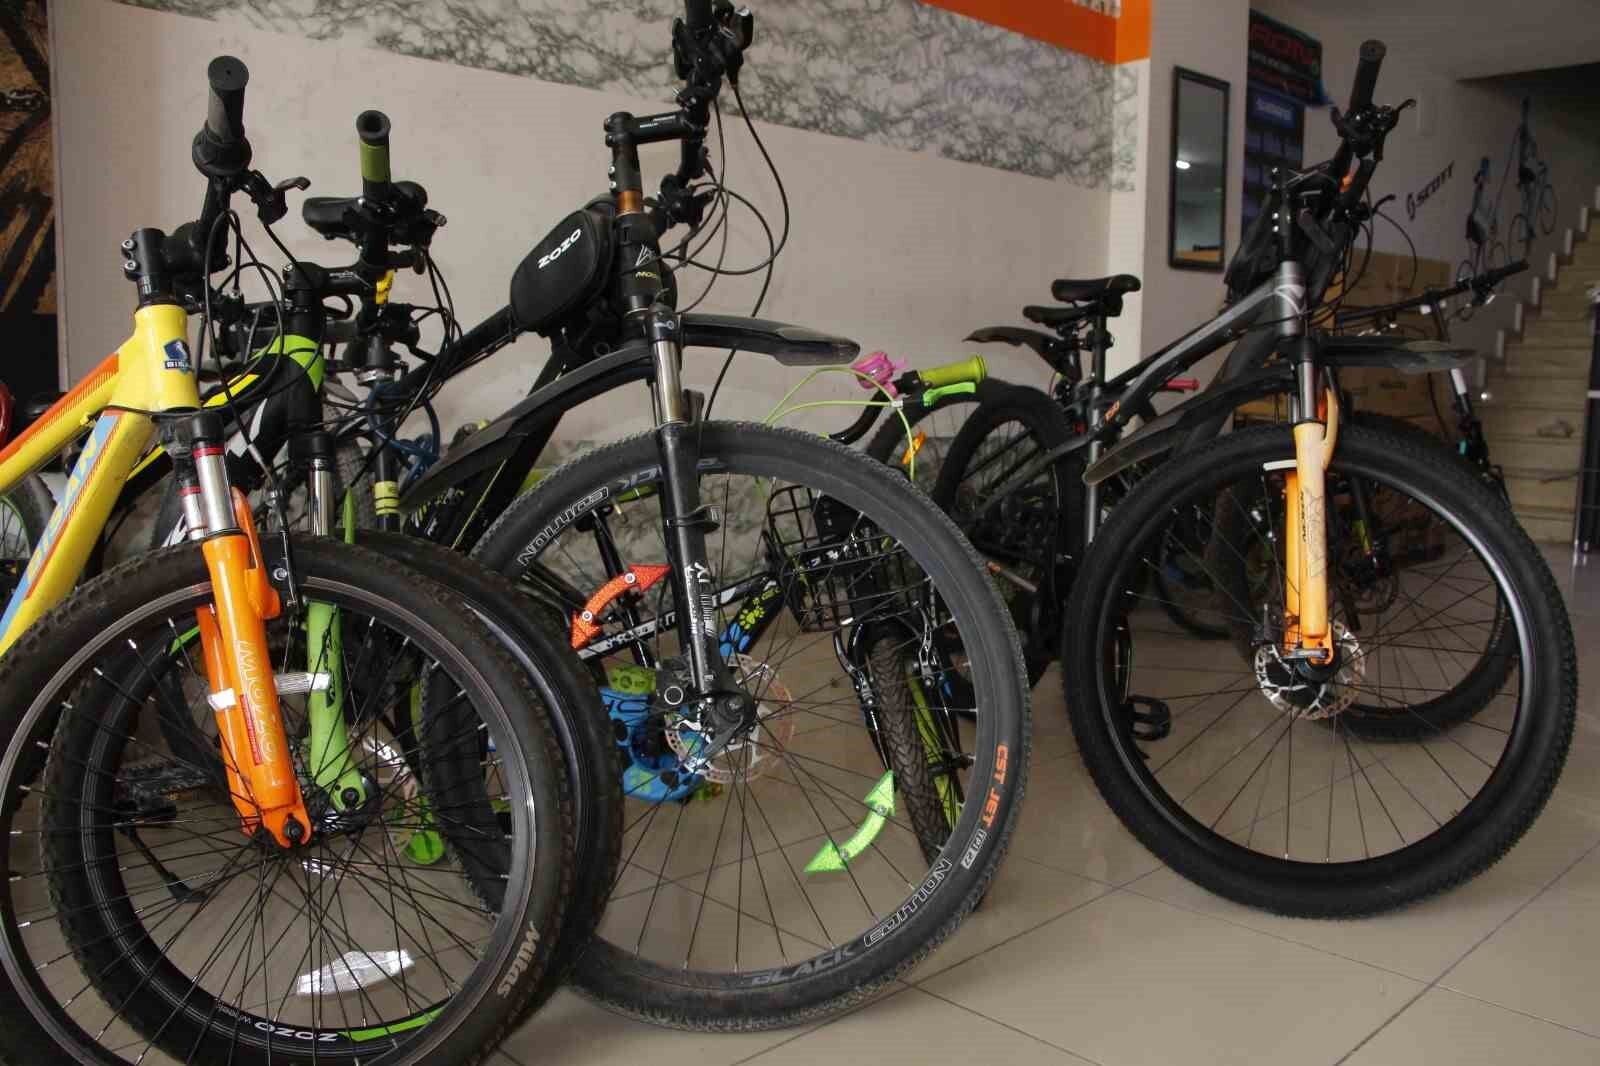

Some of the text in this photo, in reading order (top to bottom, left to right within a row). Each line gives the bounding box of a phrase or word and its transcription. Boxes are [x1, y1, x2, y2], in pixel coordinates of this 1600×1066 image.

[537, 228, 581, 269] ZOZO
[981, 744, 1009, 829] CST JET
[749, 856, 953, 985] BLACK EDITION
[254, 1021, 338, 1042] ZOZO
